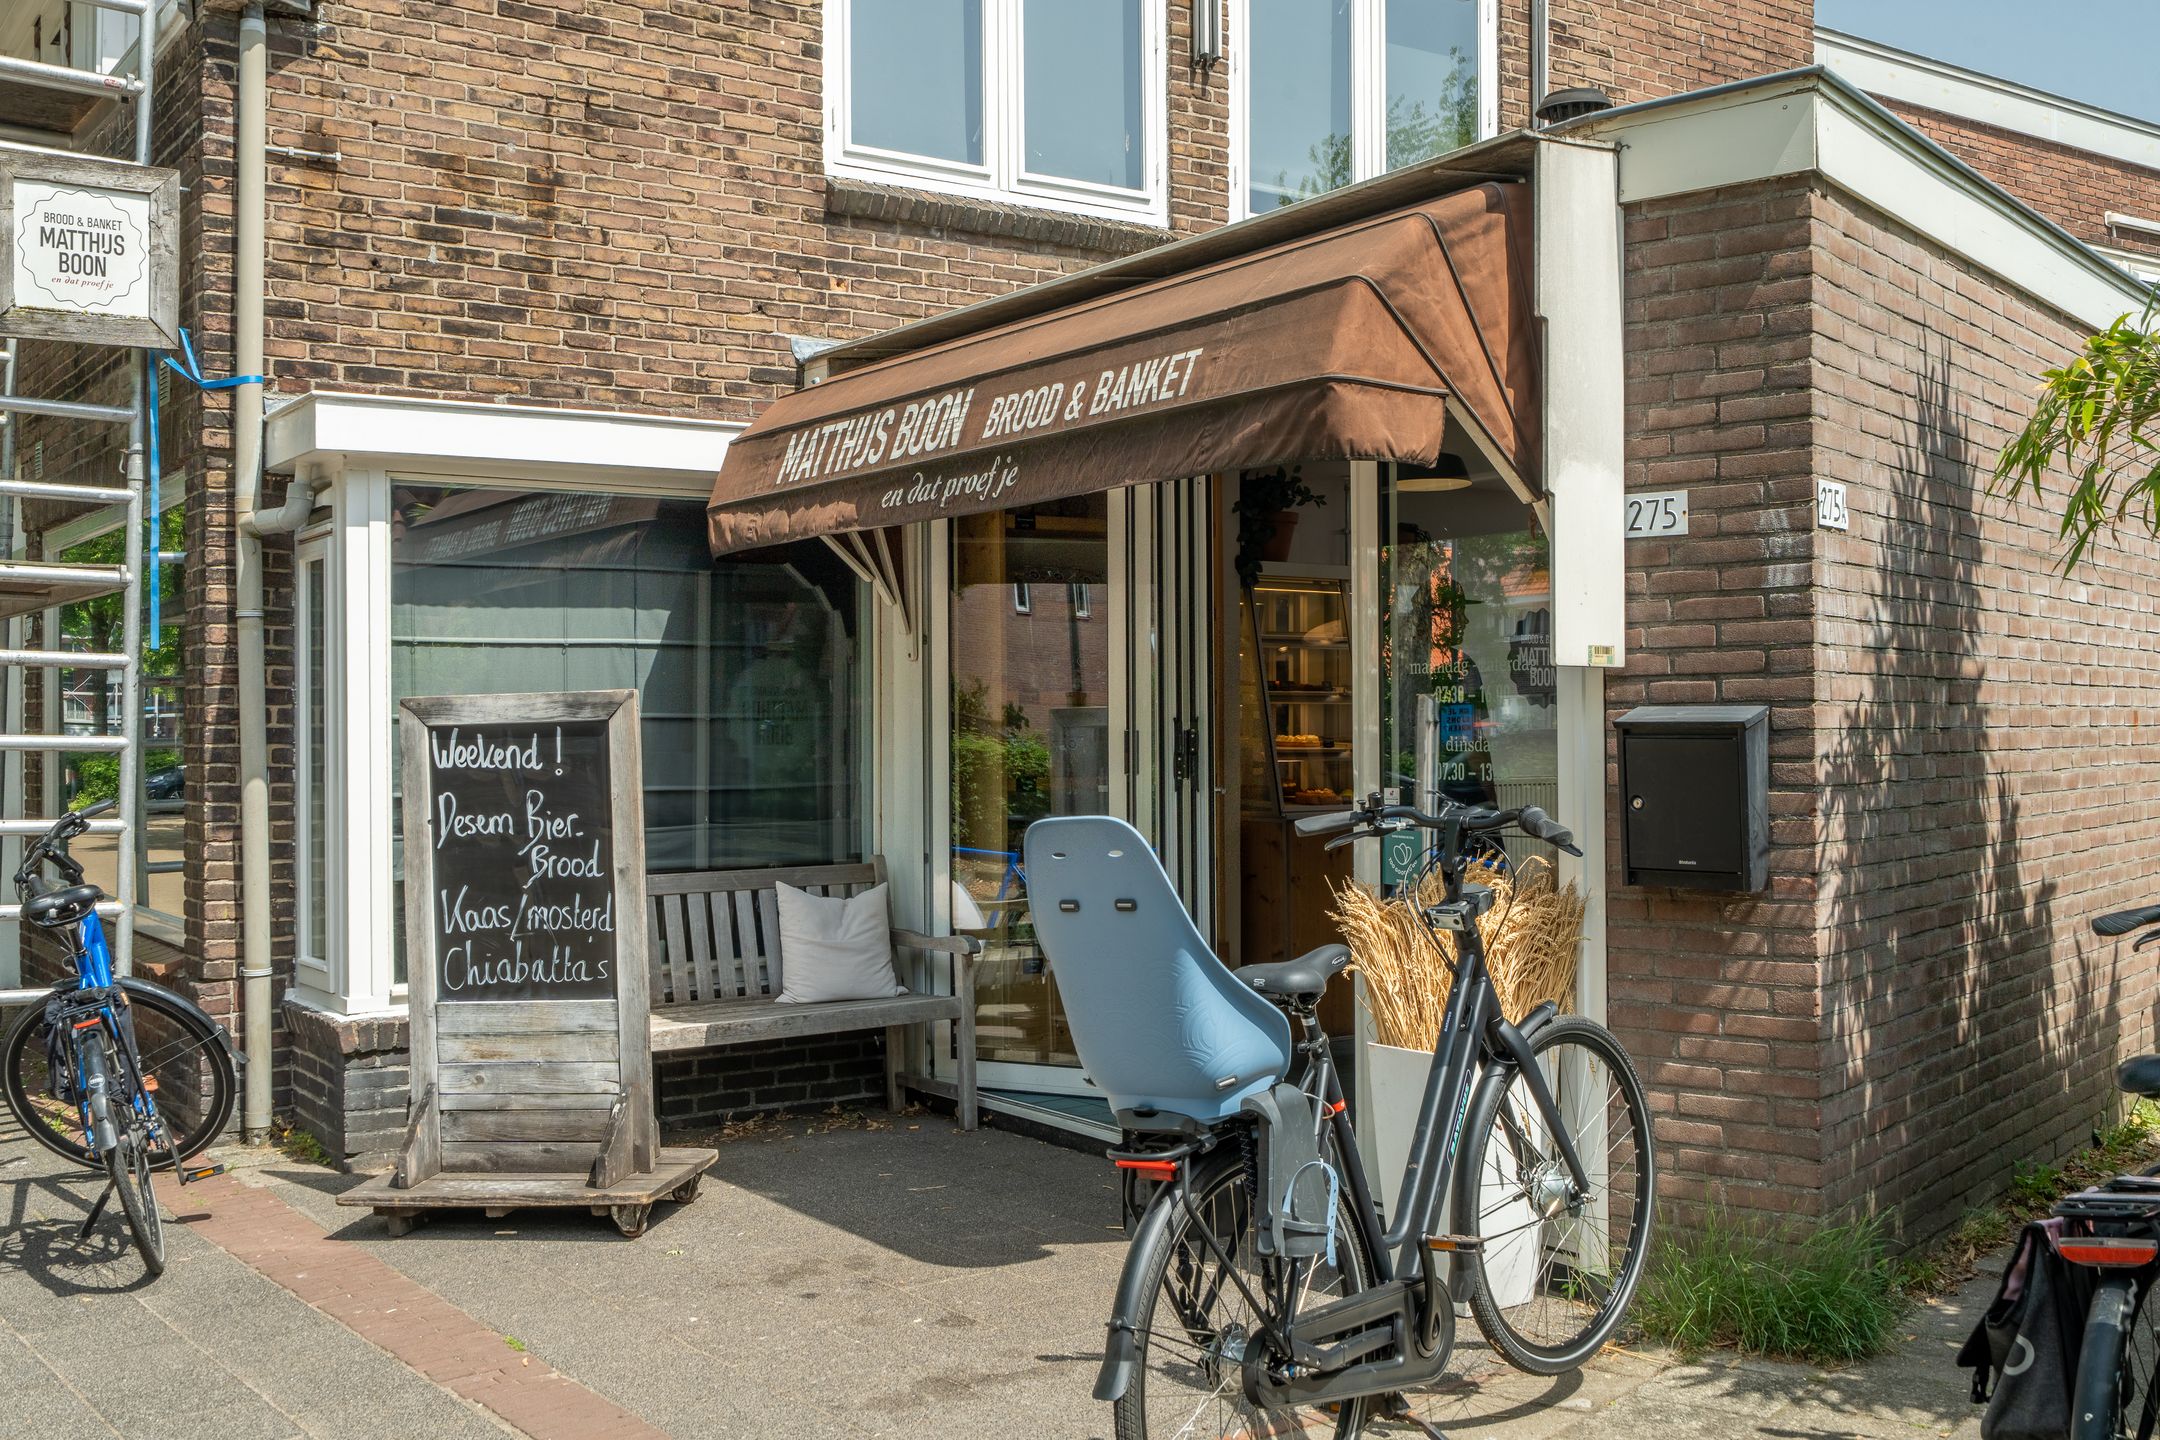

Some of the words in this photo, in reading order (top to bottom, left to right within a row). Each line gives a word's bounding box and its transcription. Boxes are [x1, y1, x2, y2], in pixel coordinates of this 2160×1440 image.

[43, 211, 74, 226] BROOD
[77, 216, 84, 227] &
[87, 217, 123, 231] BANKET
[39, 225, 125, 256] MATTHIJS
[58, 251, 107, 278] BOON
[64, 275, 79, 285] dat
[775, 408, 896, 485] MATTHIJS
[889, 388, 975, 461] BOON
[981, 382, 1065, 439] BROOD
[1063, 380, 1087, 421] &
[1088, 347, 1204, 416] BANKET
[881, 487, 904, 509] en
[907, 471, 943, 505] dat
[1628, 497, 1678, 532] 275
[1409, 658, 1469, 677] mandag
[1518, 646, 1551, 666] MATT
[1530, 667, 1557, 687] BOON
[431, 727, 543, 770] Weekend
[437, 791, 514, 849] Desem
[522, 839, 605, 890] Brood
